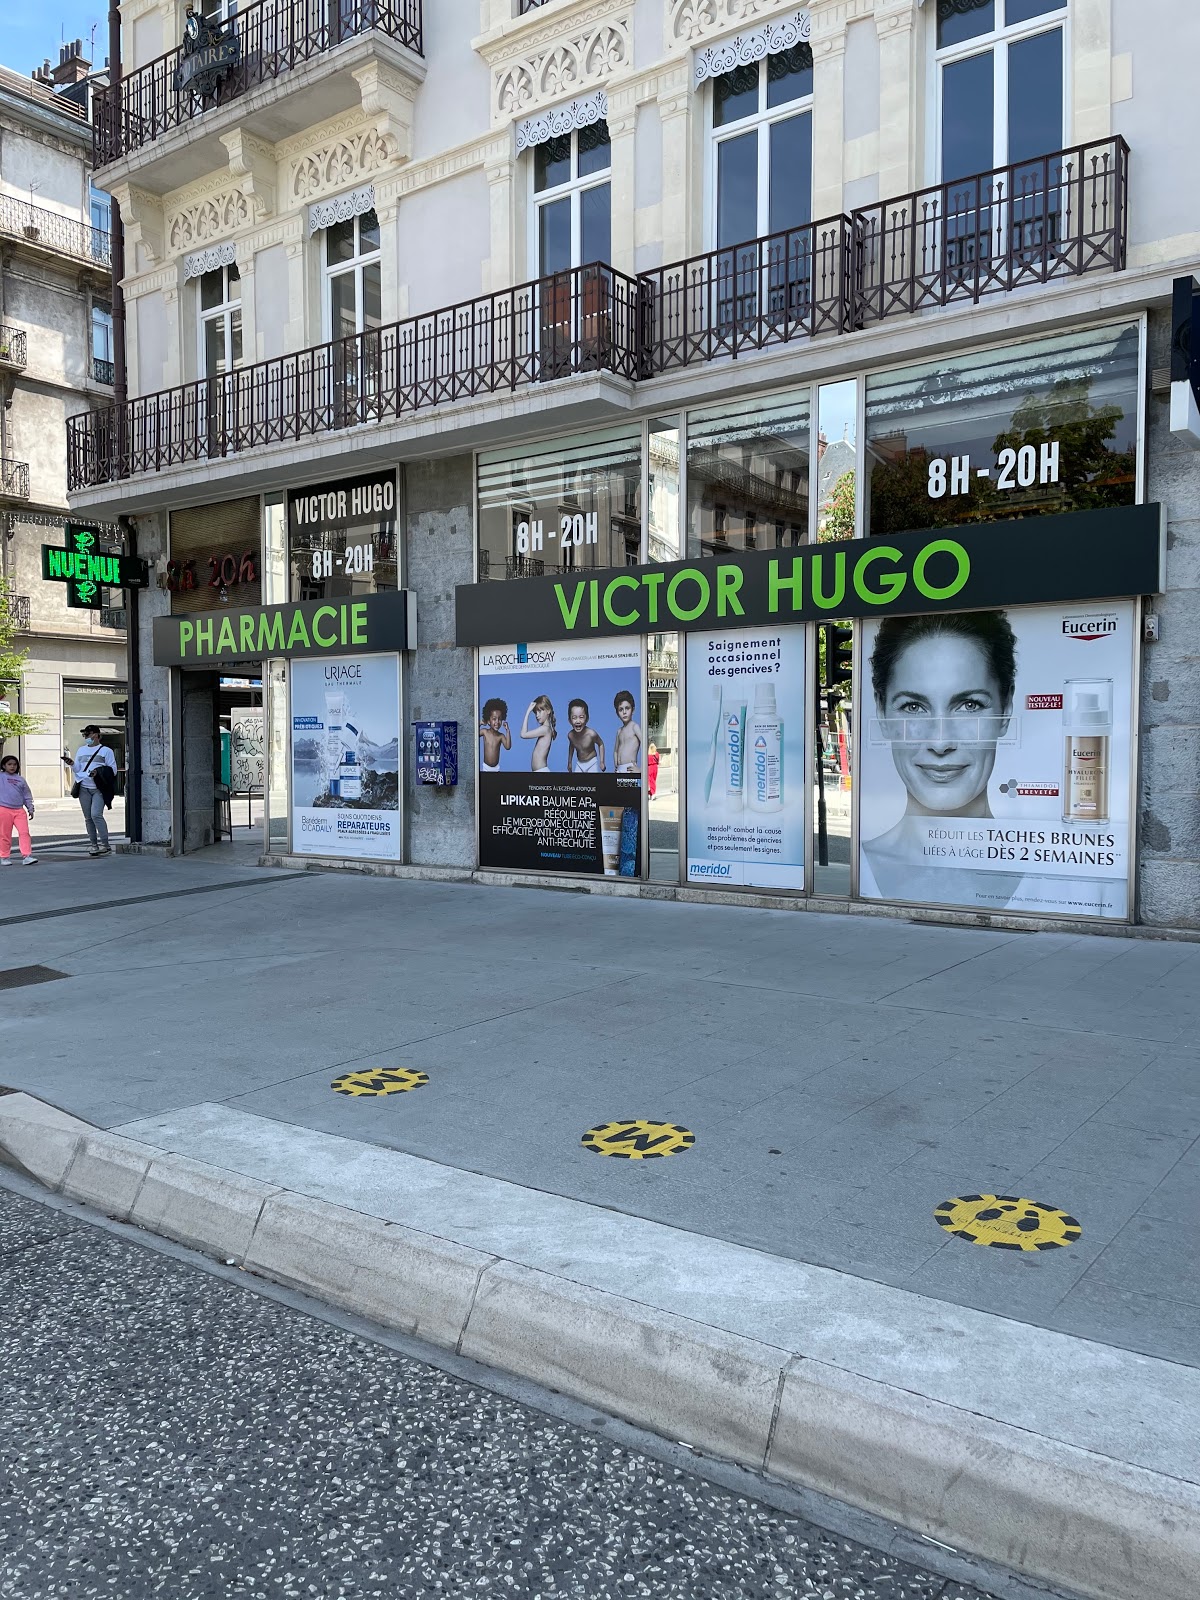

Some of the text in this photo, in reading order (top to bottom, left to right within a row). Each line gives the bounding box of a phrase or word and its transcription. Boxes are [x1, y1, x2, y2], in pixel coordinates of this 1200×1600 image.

[295, 481, 395, 525] VICTOR HUGO
[553, 539, 971, 630] VICTOR HUGO
[178, 602, 368, 657] PHARMACIE
[708, 637, 781, 652] Saignement
[483, 656, 494, 666] LA
[708, 649, 781, 664] occasionnel
[324, 665, 362, 682] URIAGE
[708, 665, 727, 676] des
[727, 664, 772, 678] gencives
[728, 729, 740, 787] meridol
[755, 751, 766, 803] meridol
[500, 795, 541, 807] LIPIKAR
[542, 796, 577, 808] BAUME
[502, 817, 513, 827] LE
[707, 833, 717, 841] des
[734, 826, 755, 834] combat
[757, 826, 763, 834] la
[928, 828, 1115, 848] RÉDUIT LES TACHES BRUNES
[923, 845, 947, 857] LIÉES
[949, 845, 956, 858] À
[987, 845, 1015, 861] DÈS
[1019, 847, 1029, 861] 2
